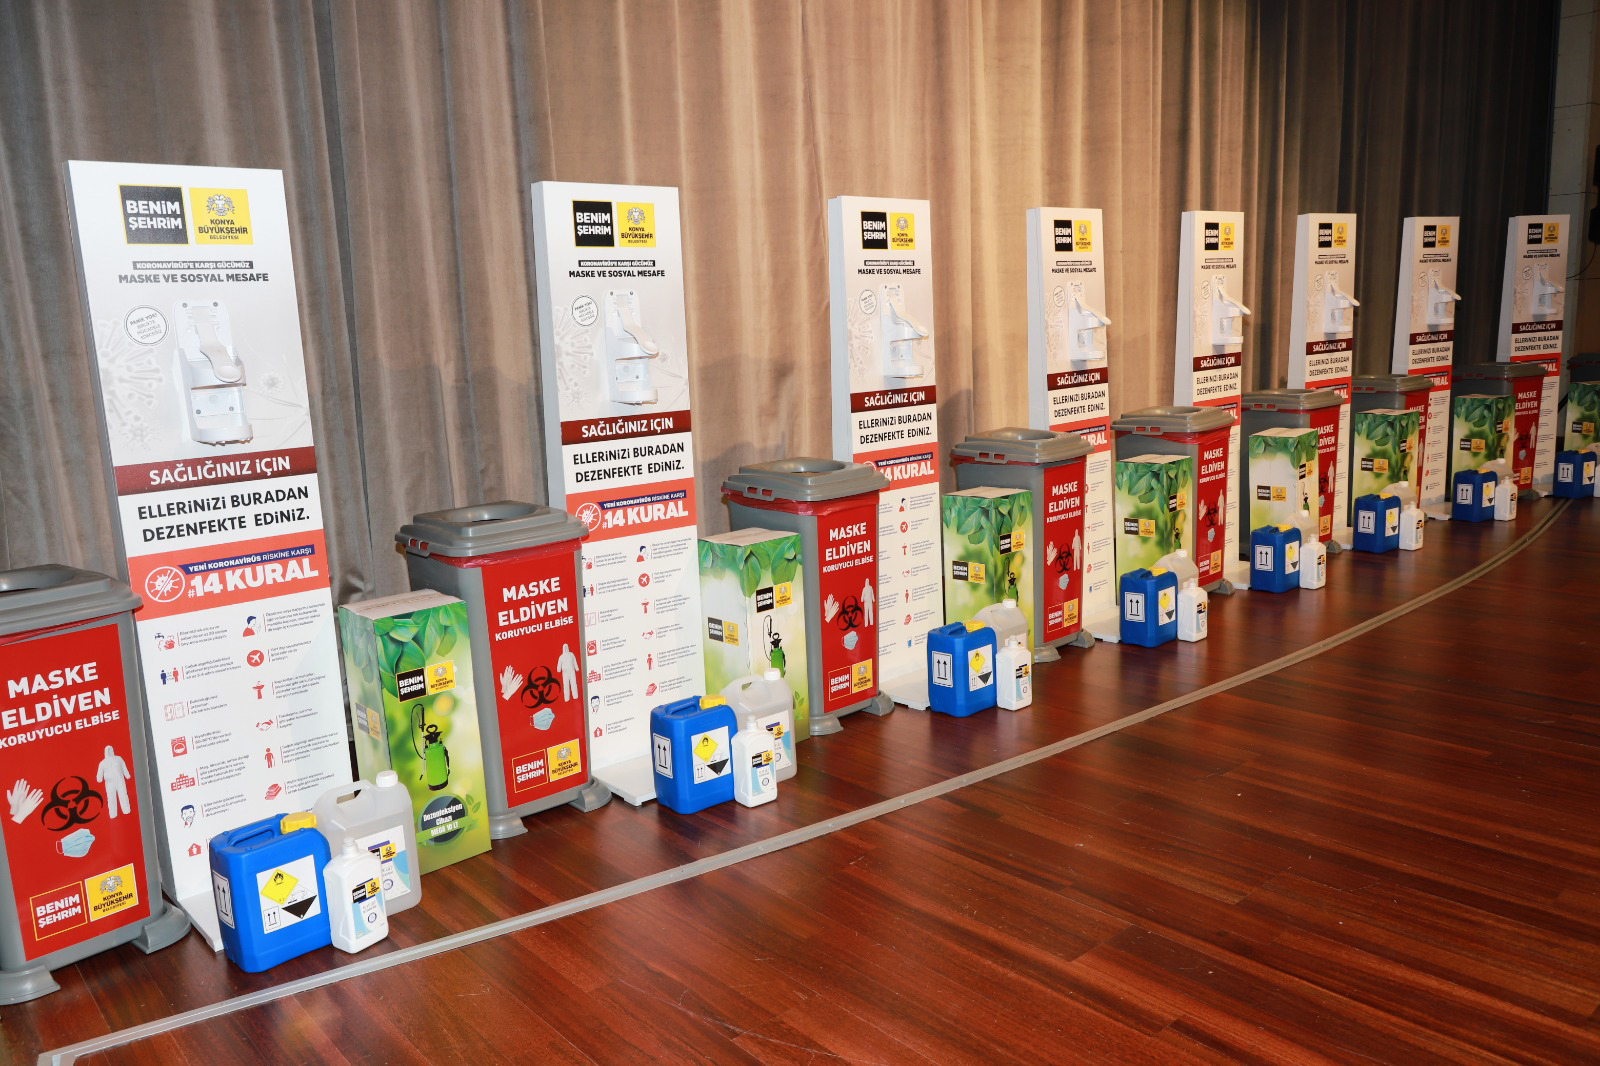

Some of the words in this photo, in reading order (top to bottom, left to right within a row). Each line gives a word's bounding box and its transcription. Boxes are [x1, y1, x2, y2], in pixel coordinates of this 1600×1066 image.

[210, 218, 235, 226] KONYA
[198, 225, 248, 235] BÜYÜKŞEHİR
[195, 261, 216, 269] KARŞI
[217, 261, 250, 269] GÜCÜMÜZ
[118, 274, 160, 284] MASKE
[163, 274, 178, 283] VE
[180, 274, 224, 283] SOSYAL
[226, 273, 269, 282] MESAFE
[569, 270, 595, 278] MASKE
[1057, 373, 1088, 386] SAĞLIĞINIZ
[864, 392, 908, 407] SAĞLIĞINIZ
[1081, 390, 1105, 401] BURADAN
[1518, 391, 1537, 400] MASKE
[898, 412, 932, 425] BURADAN
[1054, 406, 1085, 417] DEZENFEKTE
[582, 419, 648, 438] SAĞLIĞINIZ
[860, 430, 904, 445] DEZENFEKTE
[633, 442, 684, 458] BURADAN
[1204, 448, 1223, 460] MASKE
[150, 459, 251, 485] SAĞLIĞINIZ
[576, 464, 643, 483] DEZENFEKTE
[1202, 461, 1224, 474] ELDİVEN
[1052, 481, 1078, 496] MASKE
[230, 486, 309, 508] BURADAN
[1049, 496, 1080, 513] ELDİVEN
[143, 515, 246, 542] DEZENFEKTE
[829, 522, 866, 541] MASKE
[825, 540, 871, 561] ELDİVEN
[189, 563, 207, 573] YENİ
[208, 555, 261, 570] KORONAVİRÜS
[262, 550, 290, 561] RİSKİNE
[290, 547, 312, 558] KARŞI
[823, 560, 853, 573] KORUYUCU
[502, 577, 561, 602] MASKE
[498, 597, 568, 627] ELDİVEN
[495, 622, 542, 641] KORUYUCU
[545, 616, 574, 631] ELBİSE
[7, 661, 99, 699] MASKE
[1, 687, 111, 730] ELDİVEN
[0, 721, 72, 749] KORUYUCU
[75, 710, 120, 730] ELBİSE
[103, 891, 122, 901] KONYA
